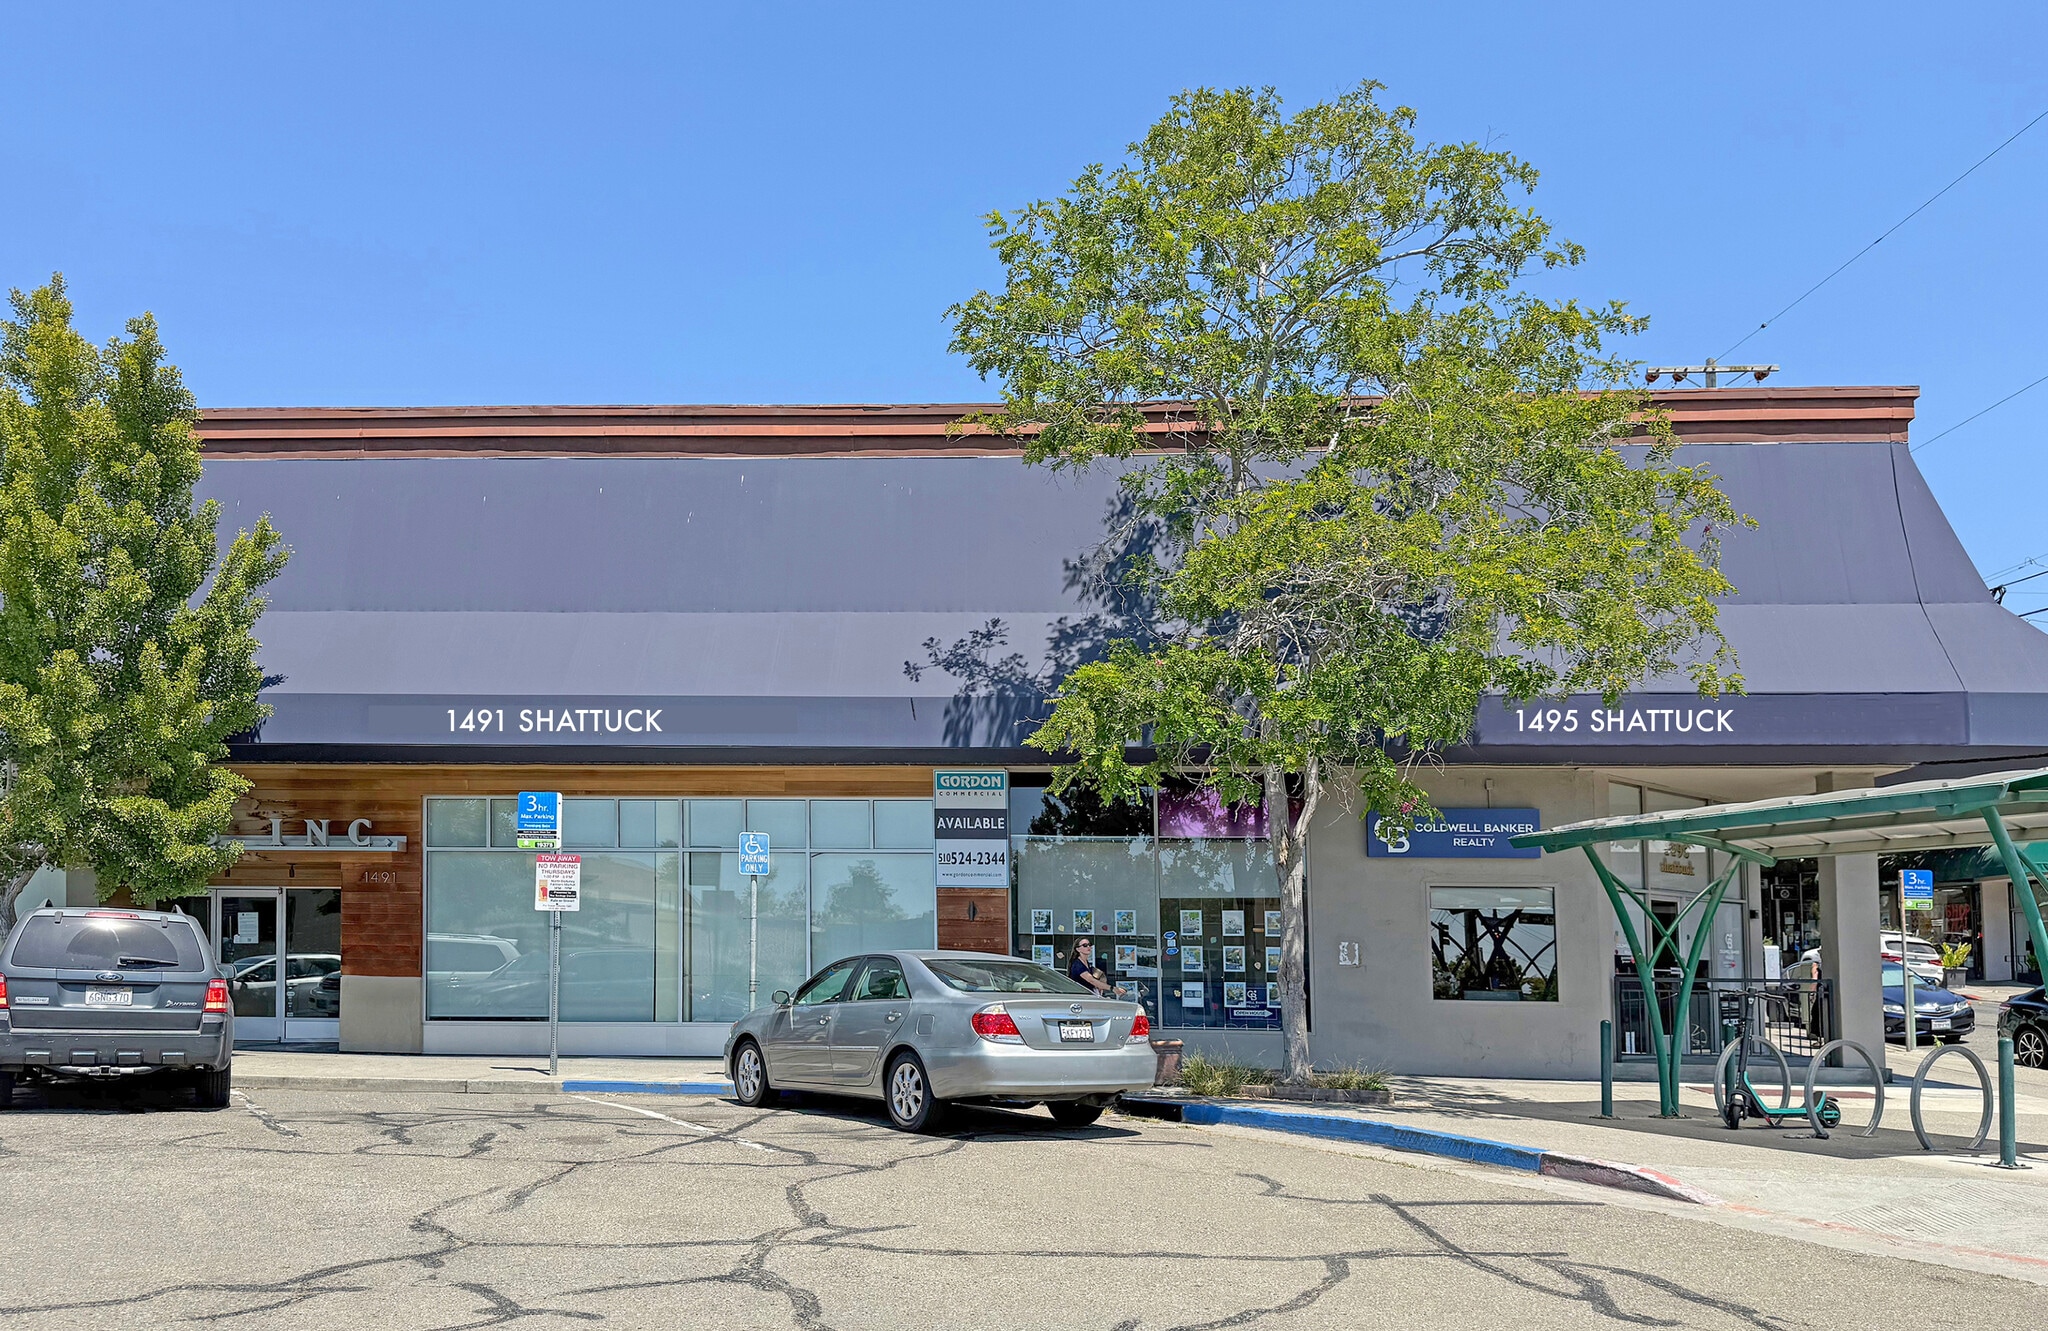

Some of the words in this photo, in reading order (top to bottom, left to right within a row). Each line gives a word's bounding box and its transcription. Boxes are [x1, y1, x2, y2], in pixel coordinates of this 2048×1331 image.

[447, 708, 504, 732] 1491
[519, 708, 663, 732] SHATTUCK
[1515, 708, 1579, 732] 1495
[1590, 708, 1734, 732] SHATTUCK
[940, 775, 1001, 788] GORDON
[937, 817, 1005, 829] AVAILABLE
[1415, 823, 1481, 833] COLDWELL
[1484, 823, 1534, 833] BANKER
[1453, 838, 1495, 847] REALTY
[741, 854, 768, 863] PARKING
[745, 863, 763, 872] ONLY
[364, 871, 397, 883] 1491
